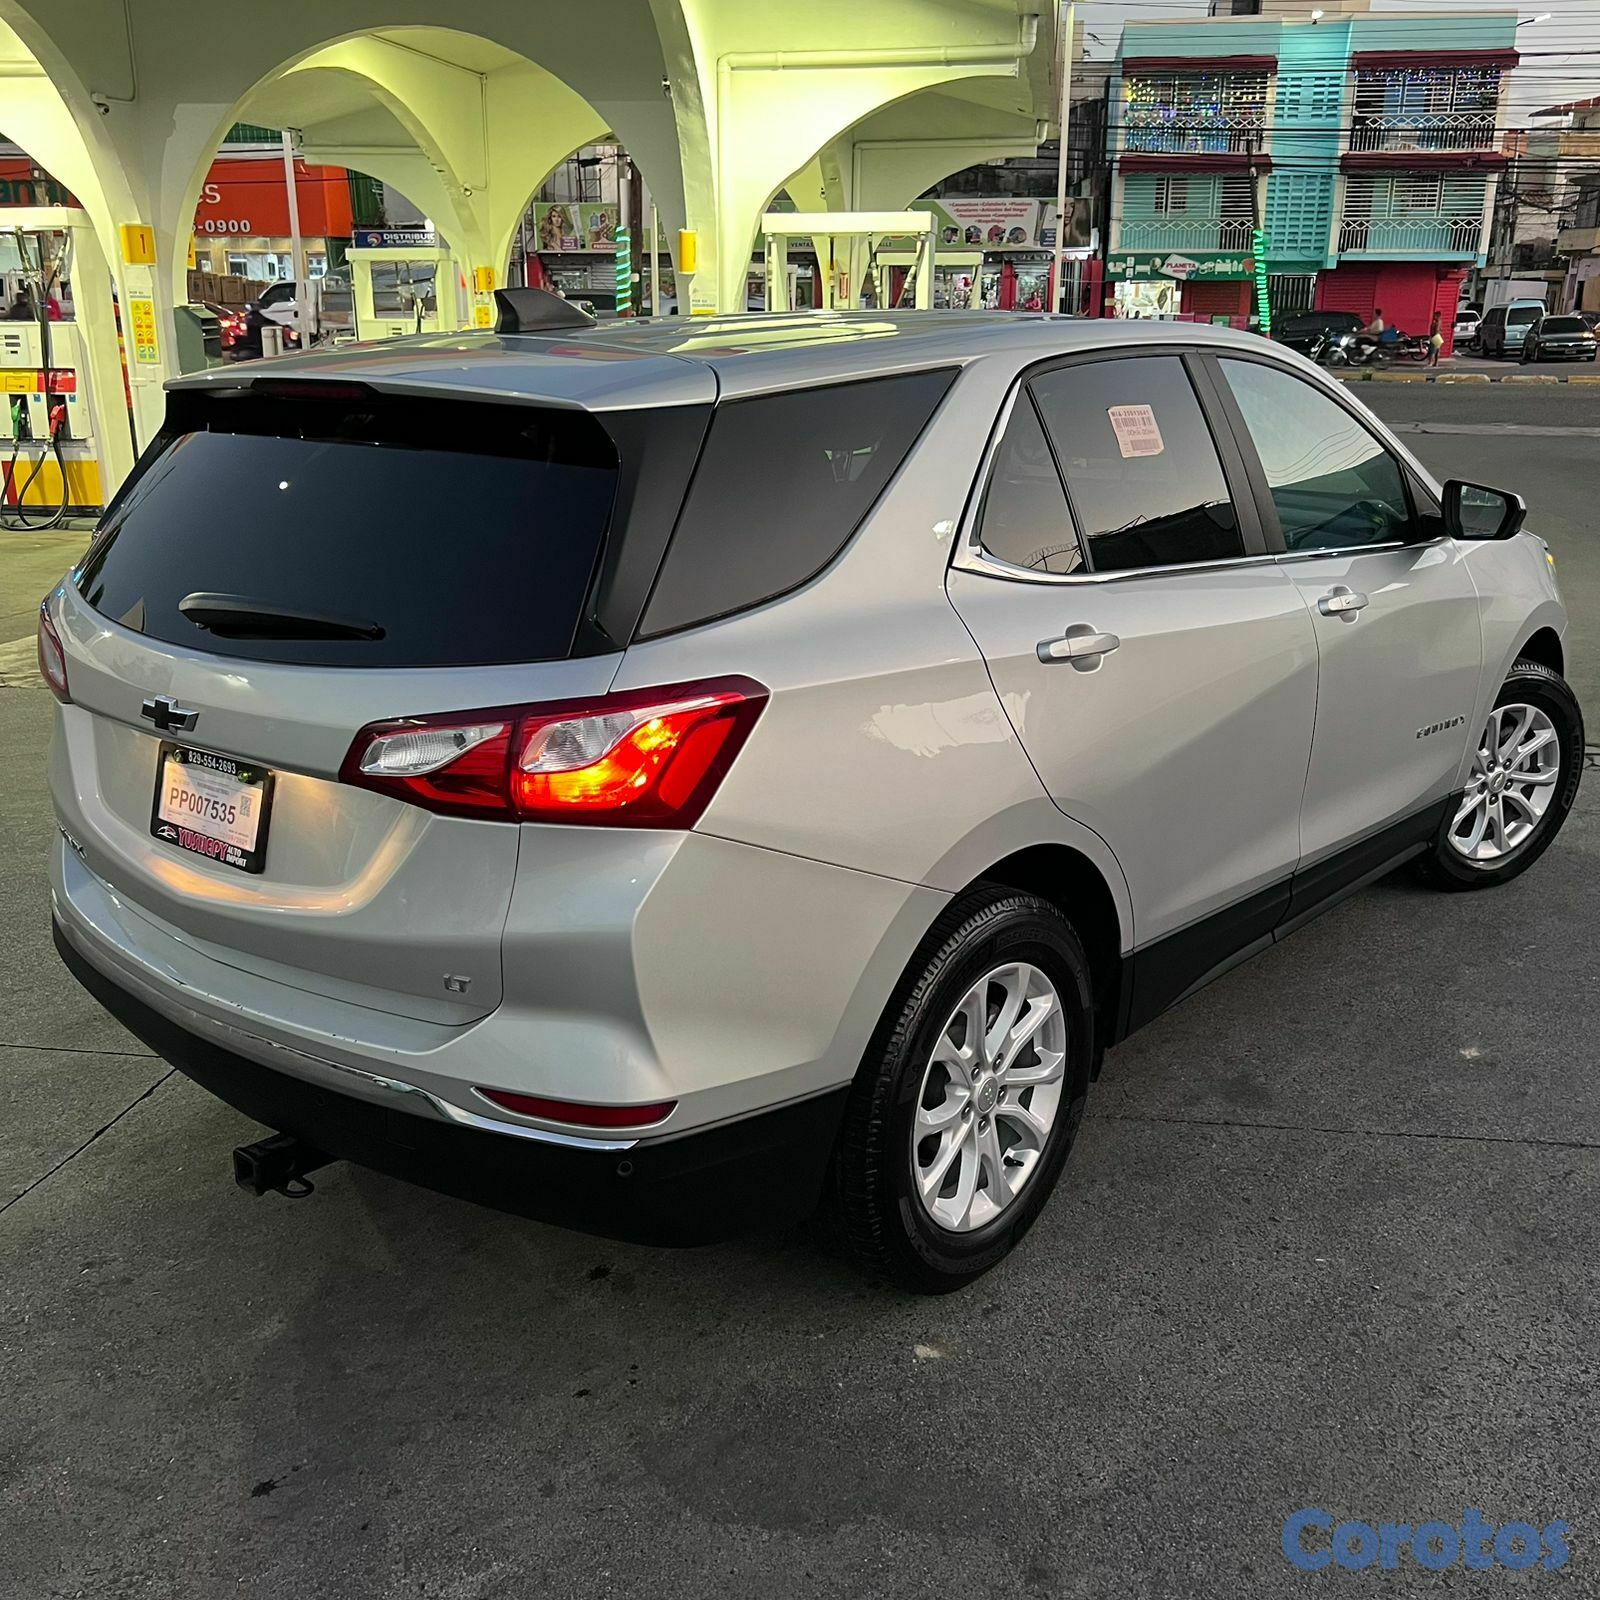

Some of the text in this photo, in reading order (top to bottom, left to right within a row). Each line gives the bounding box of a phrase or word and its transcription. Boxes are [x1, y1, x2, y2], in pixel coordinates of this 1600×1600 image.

[140, 234, 146, 254] 1
[188, 751, 237, 775] 829-554-2693
[169, 787, 236, 825] PP007535
